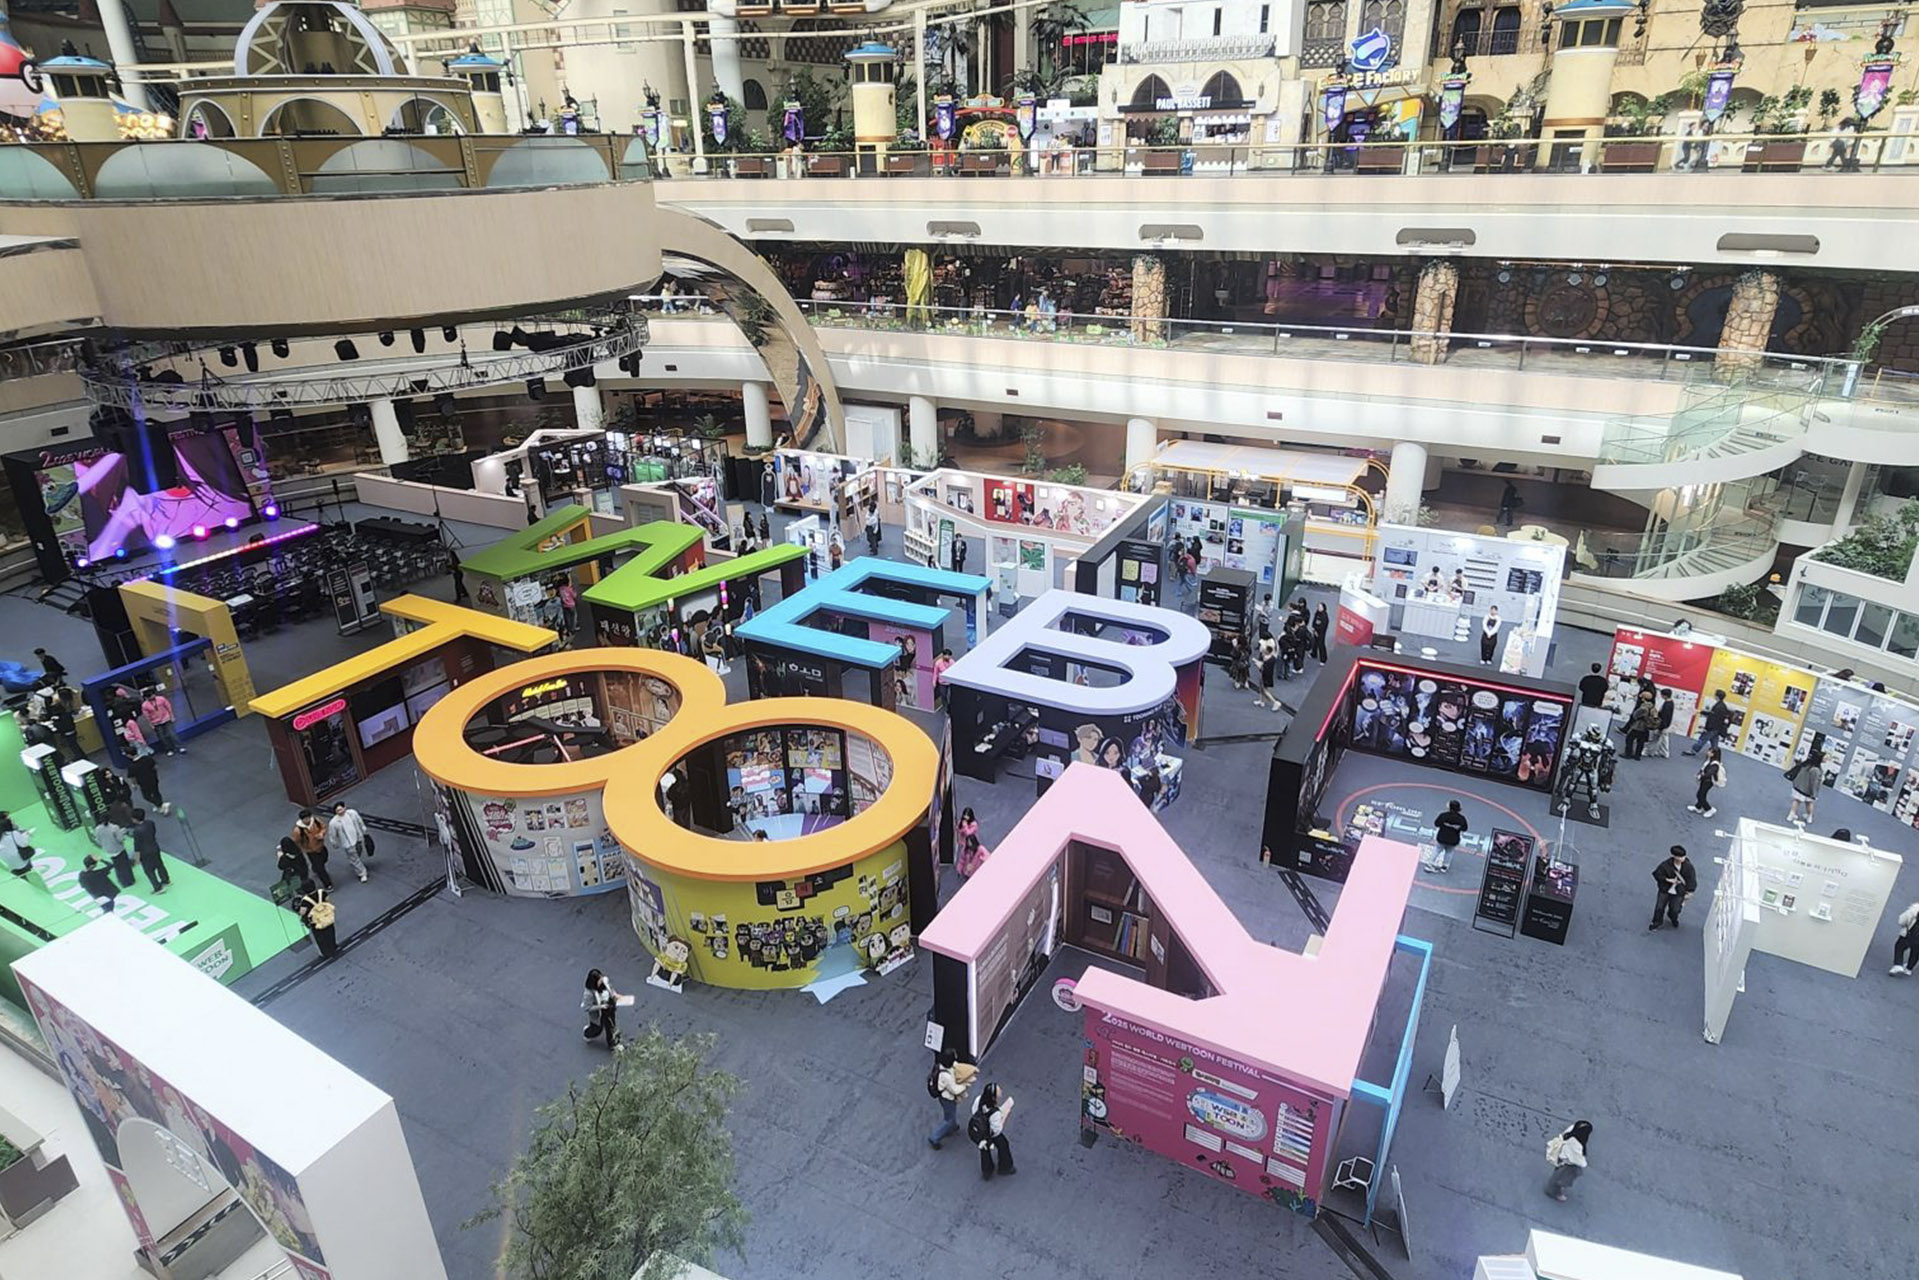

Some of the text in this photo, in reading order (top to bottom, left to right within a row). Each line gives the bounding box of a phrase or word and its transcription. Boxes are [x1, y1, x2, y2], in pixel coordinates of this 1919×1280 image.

[1366, 68, 1419, 86] FACTORY
[1156, 97, 1177, 110] PAUL
[1102, 1011, 1128, 1030] 2025
[1129, 1023, 1164, 1043] WORLD
[1165, 1035, 1215, 1062] WEBTOON
[1216, 1055, 1261, 1080] FESTIVAL
[1214, 1112, 1245, 1129] TOON
